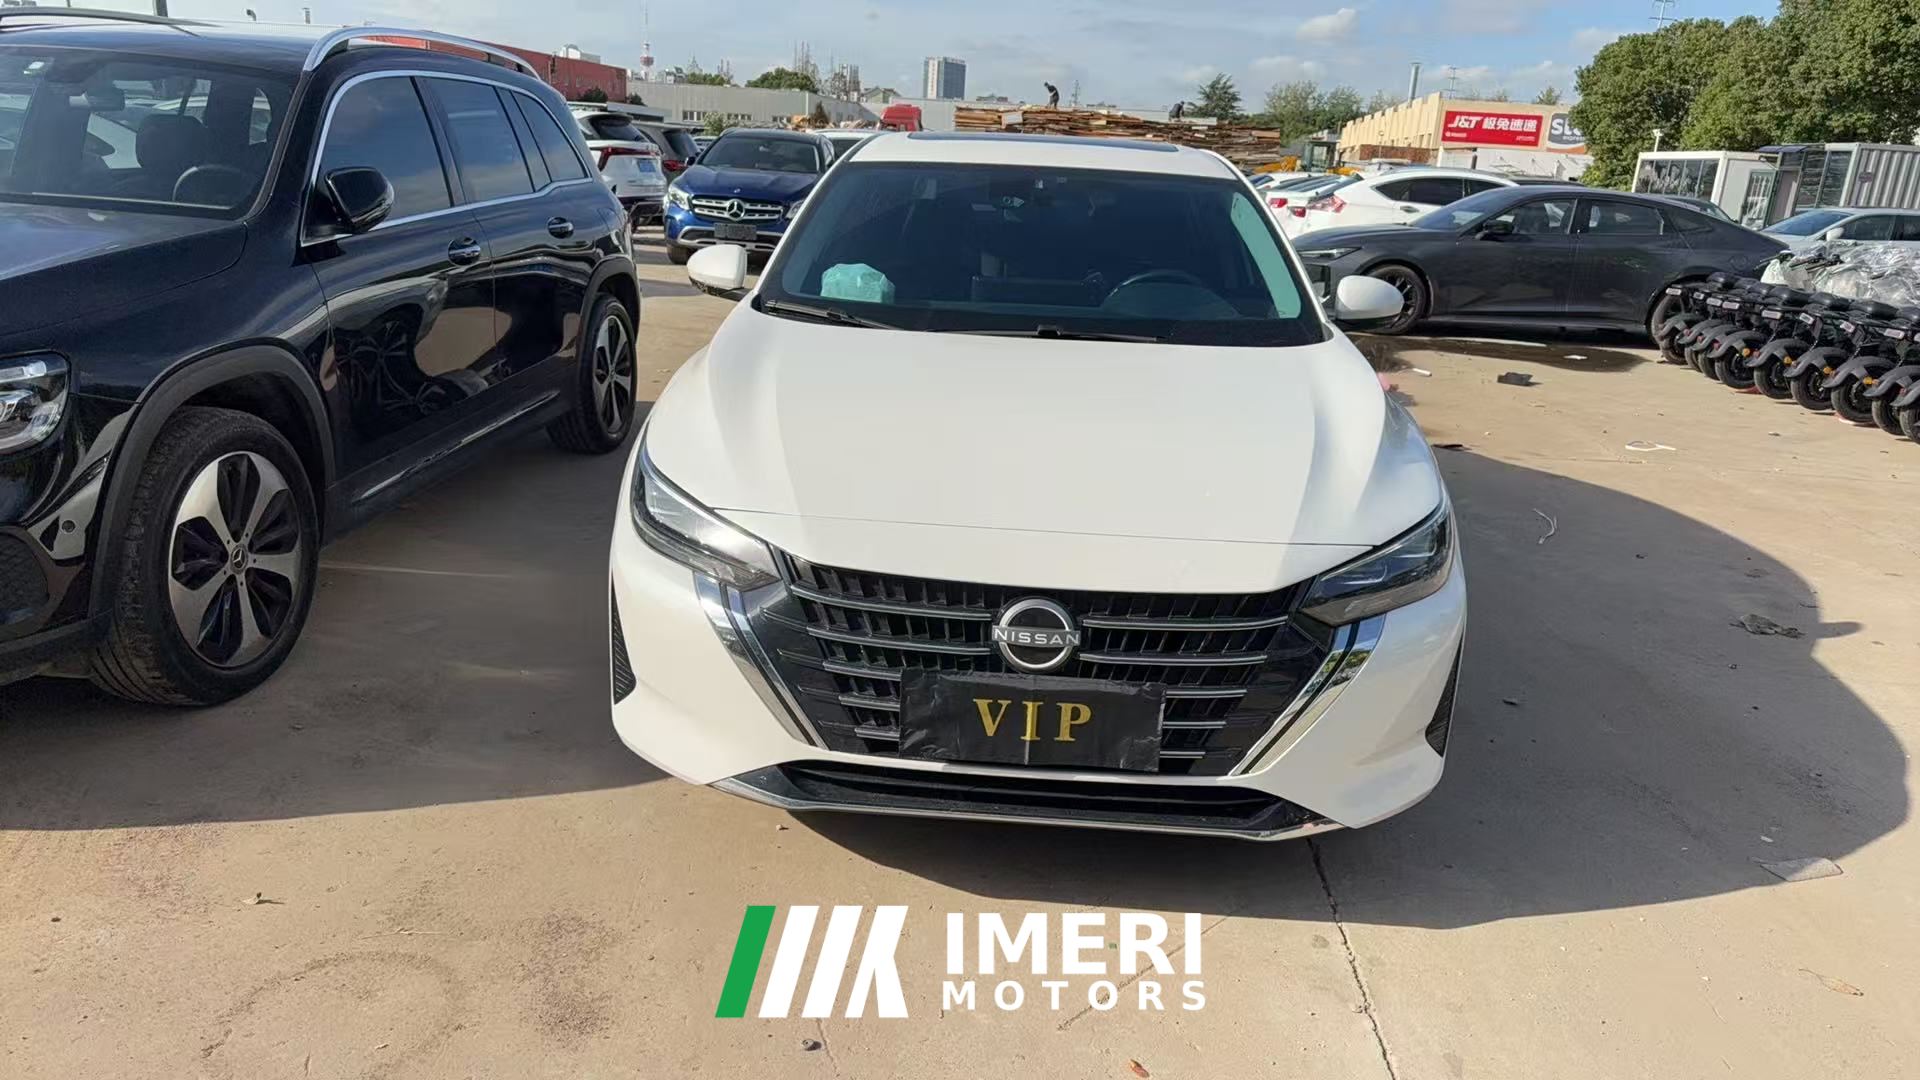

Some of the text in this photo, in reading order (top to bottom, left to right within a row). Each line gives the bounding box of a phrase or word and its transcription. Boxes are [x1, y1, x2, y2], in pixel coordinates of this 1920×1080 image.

[1448, 115, 1482, 129] J&T
[993, 628, 1080, 646] NISSAN
[973, 698, 1092, 742] VIP
